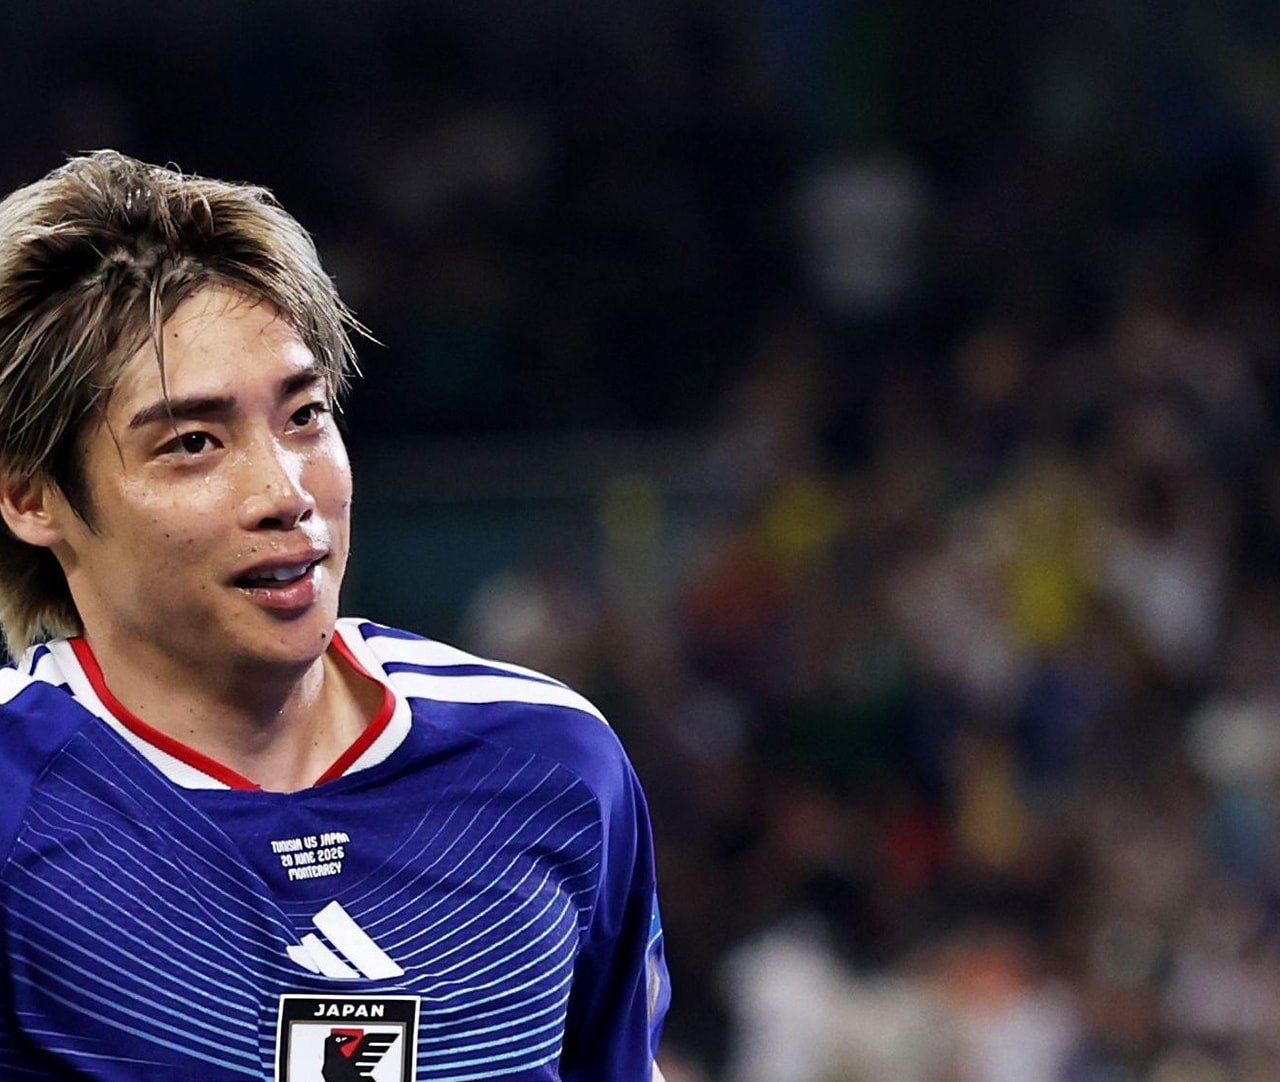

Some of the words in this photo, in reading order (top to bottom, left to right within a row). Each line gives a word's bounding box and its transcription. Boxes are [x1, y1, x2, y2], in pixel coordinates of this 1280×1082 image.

[271, 838, 303, 853] TUNISIA
[320, 832, 350, 847] JAPAN
[281, 854, 293, 867] 20
[294, 851, 316, 866] JUNE
[317, 846, 345, 862] 2026
[288, 861, 342, 881] MONTERREY
[313, 1003, 385, 1017] JAPAN
